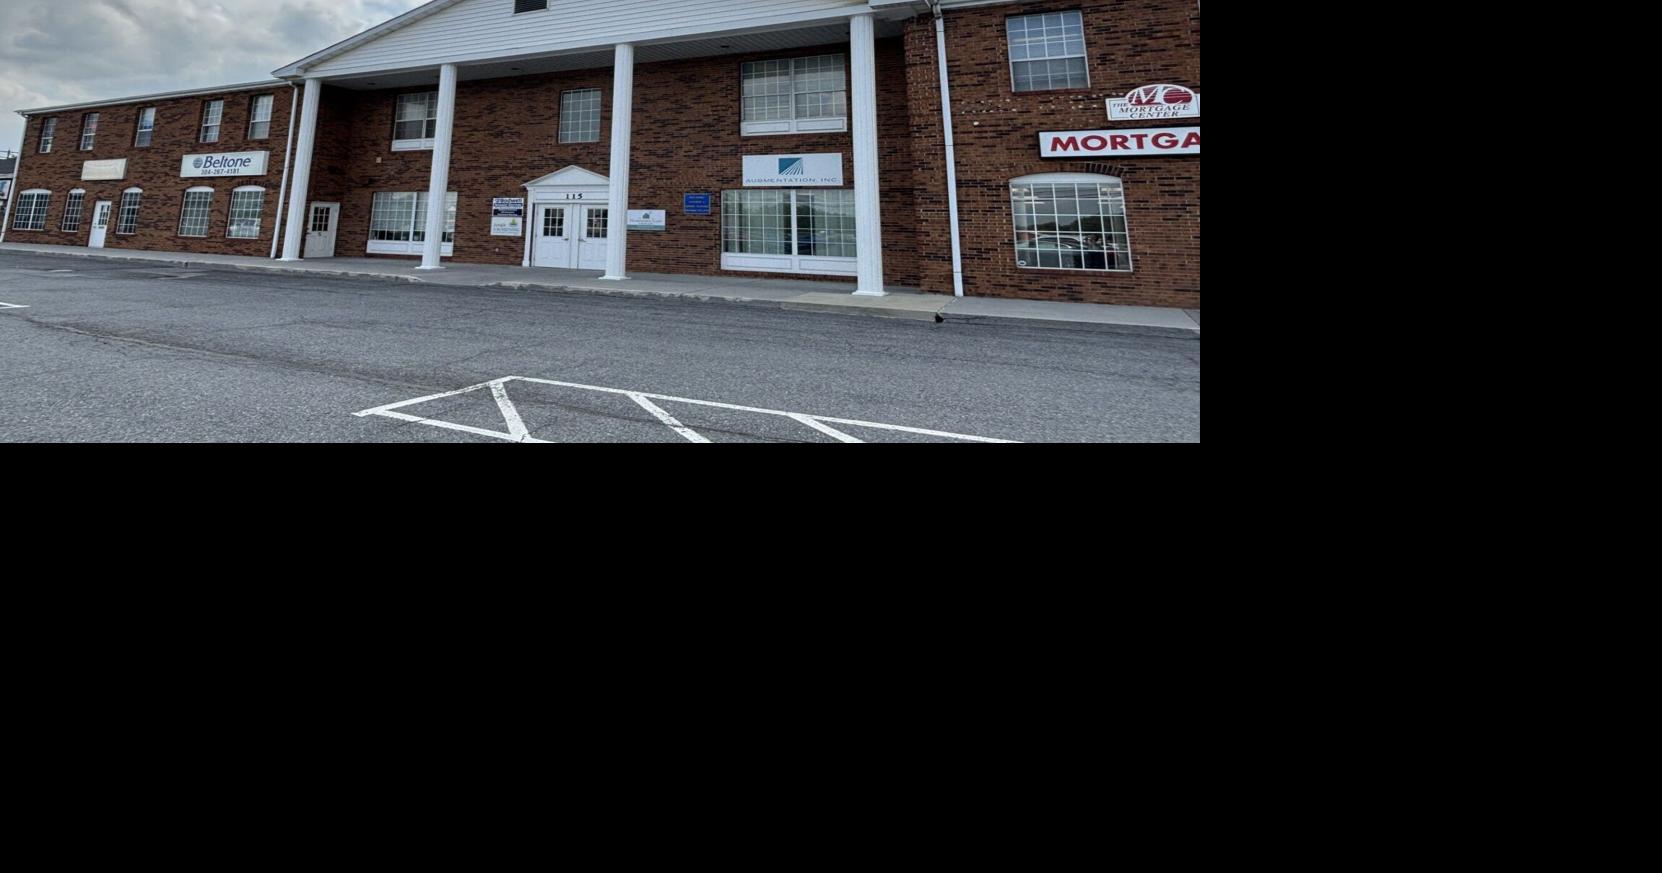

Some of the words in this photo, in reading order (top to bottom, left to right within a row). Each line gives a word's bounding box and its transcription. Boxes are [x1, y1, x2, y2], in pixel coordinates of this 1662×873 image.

[1119, 105, 1190, 113] MORTGAGE
[1051, 132, 1200, 151] MORTGA
[203, 156, 251, 168] Beltone
